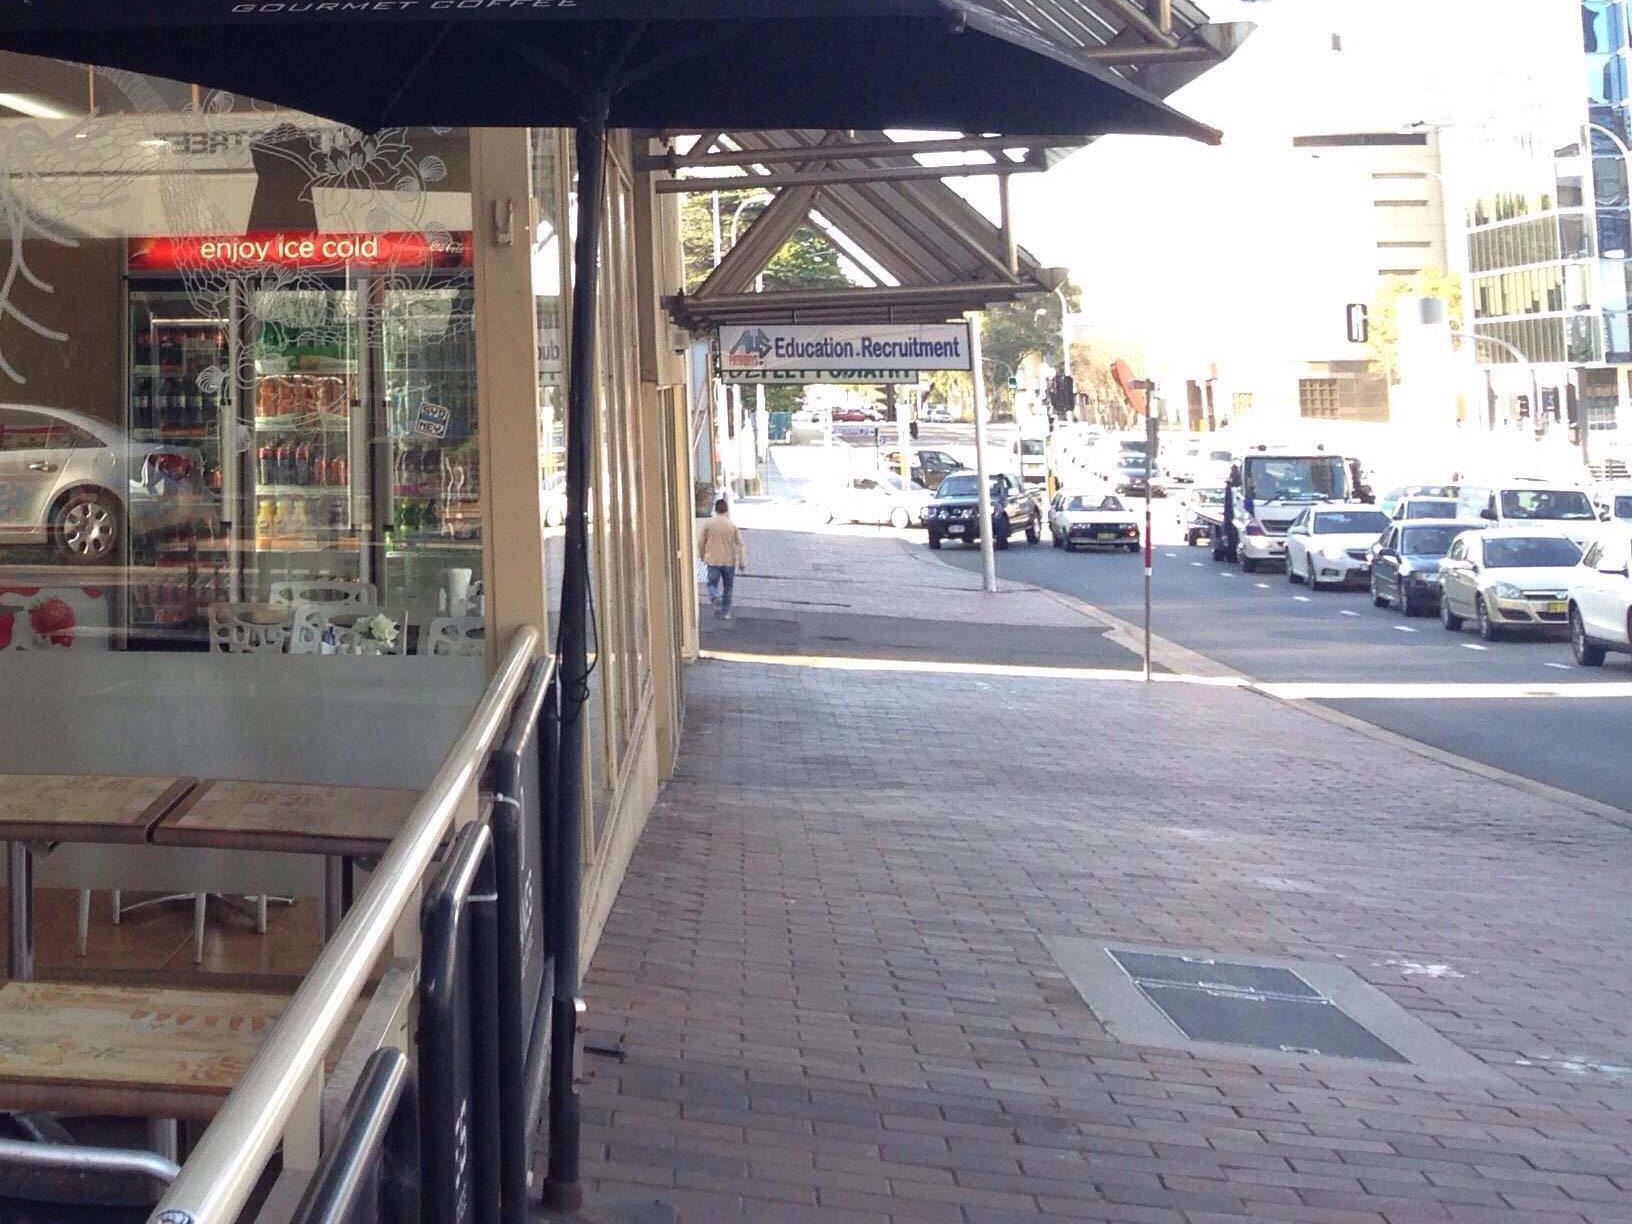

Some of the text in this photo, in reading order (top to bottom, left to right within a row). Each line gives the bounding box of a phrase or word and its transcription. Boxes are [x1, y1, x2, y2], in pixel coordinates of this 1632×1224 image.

[232, 0, 417, 13] GOURMET
[200, 236, 269, 265] enjoy
[277, 236, 316, 259] ice
[321, 236, 378, 259] cold
